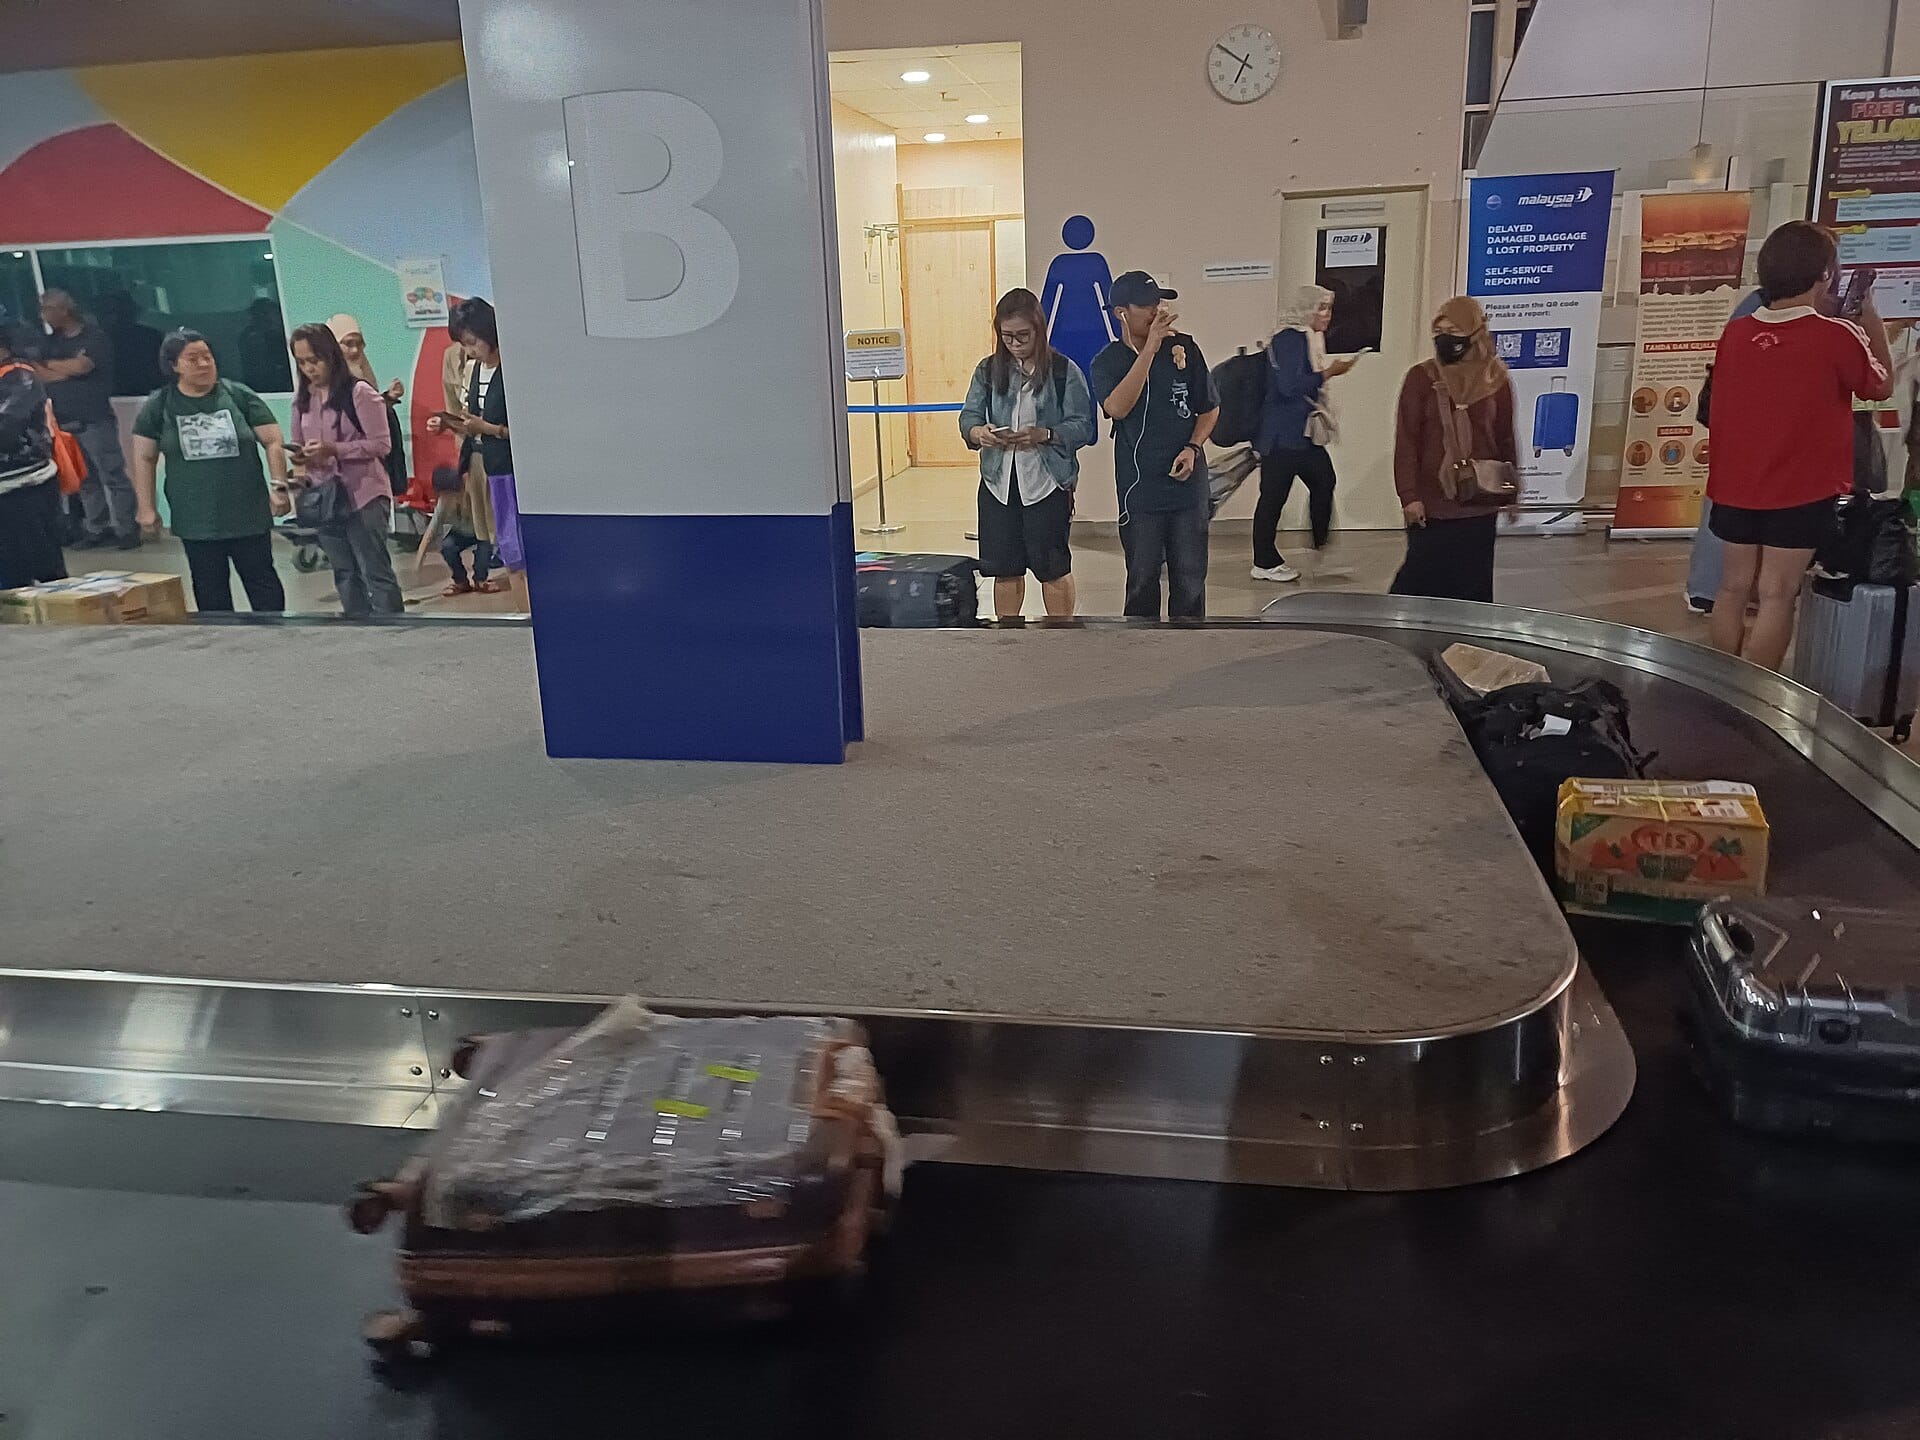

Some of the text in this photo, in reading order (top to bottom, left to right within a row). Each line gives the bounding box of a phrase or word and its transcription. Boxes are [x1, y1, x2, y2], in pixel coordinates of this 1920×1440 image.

[1852, 101, 1904, 118] FREE
[1518, 193, 1575, 207] malaysia
[562, 88, 740, 339] B
[1487, 224, 1533, 234] DELAYED
[1487, 232, 1587, 244] DAMAGED BAGGAGE
[1486, 243, 1575, 255] & LOST PROPERTY
[1485, 265, 1554, 276] SELF-SERVICE
[1484, 276, 1541, 286] REPORTING
[1485, 302, 1511, 311] Please
[1531, 300, 1544, 309] the
[1545, 300, 1558, 308] QR
[1559, 299, 1579, 307] code
[1495, 310, 1516, 319] make
[857, 335, 890, 345] NOTICE
[1645, 343, 1671, 352] TANDA
